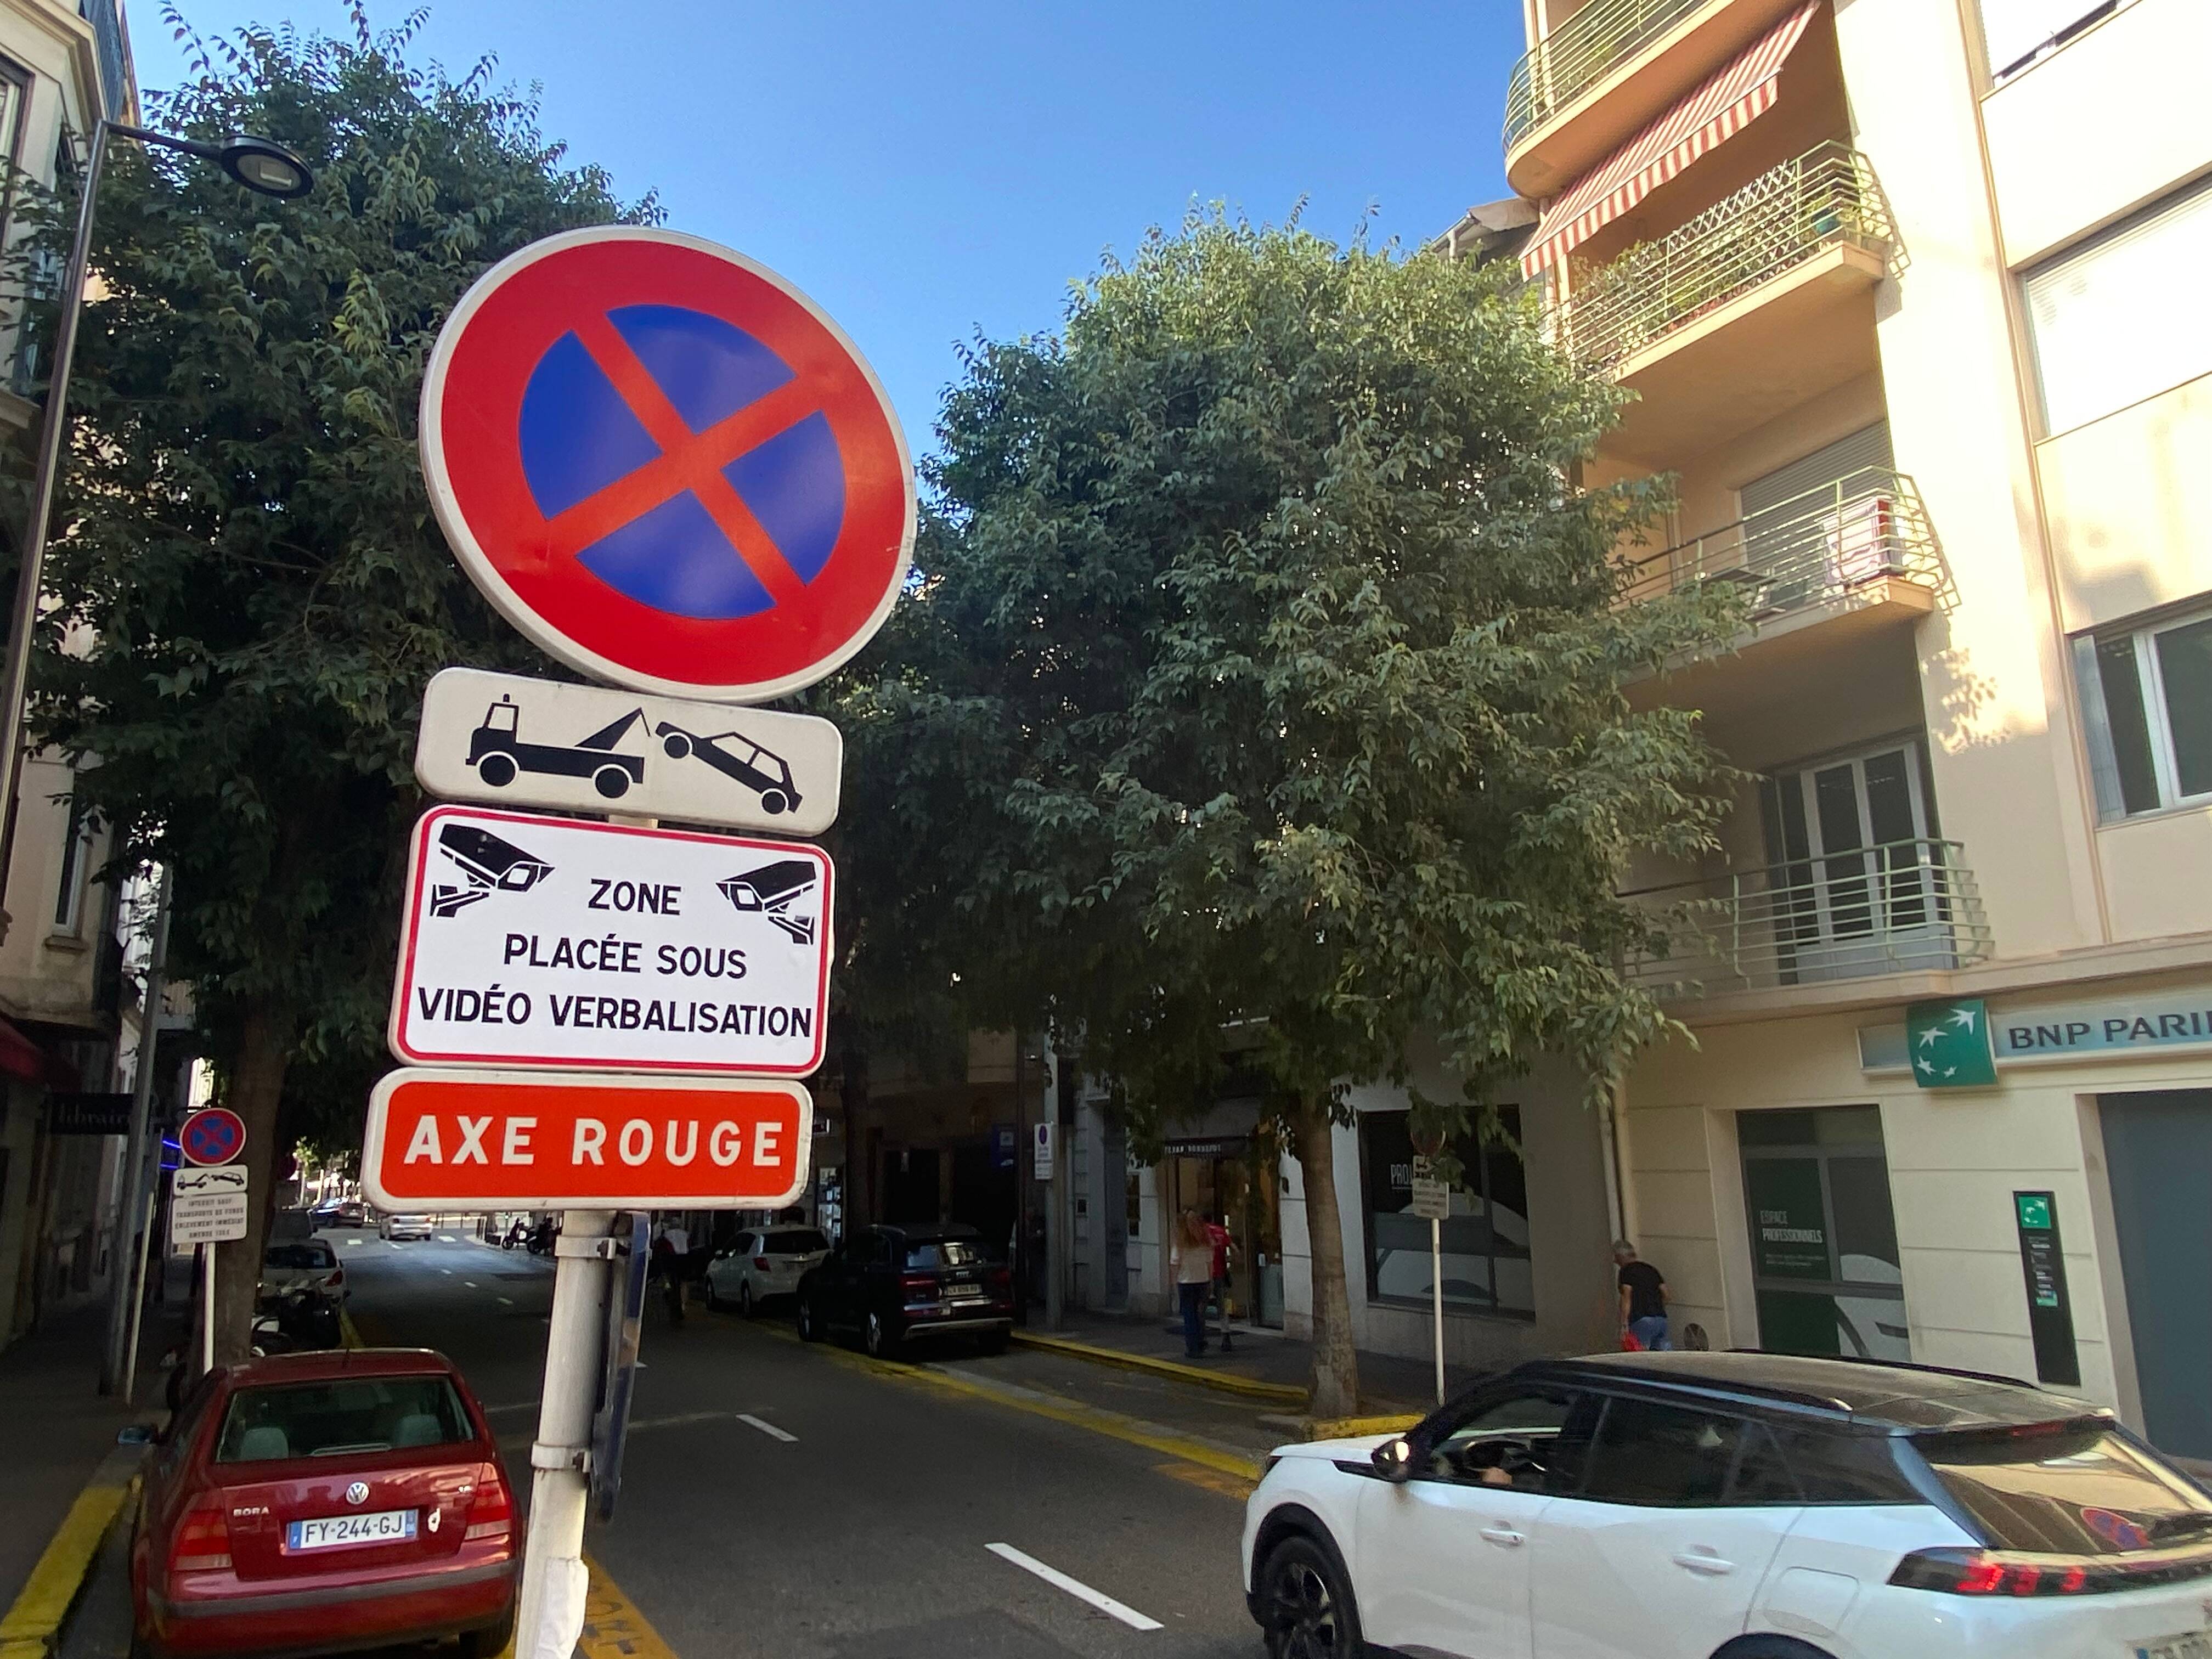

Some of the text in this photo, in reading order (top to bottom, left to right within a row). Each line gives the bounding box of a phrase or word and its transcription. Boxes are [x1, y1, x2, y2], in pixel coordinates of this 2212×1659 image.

[588, 879, 681, 915] ZONE
[504, 934, 746, 979] PLACÉE SOUS
[419, 984, 811, 1037] VIDÉO VERBALISATION
[2009, 1023, 2090, 1049] BNP
[404, 1115, 782, 1166] AXE ROUGE
[1760, 1210, 1788, 1224] ESPACE
[1762, 1228, 1823, 1244] PROFESSIONNELS
[234, 1506, 269, 1517] BORA
[305, 1515, 403, 1543] FY-244-GJ
